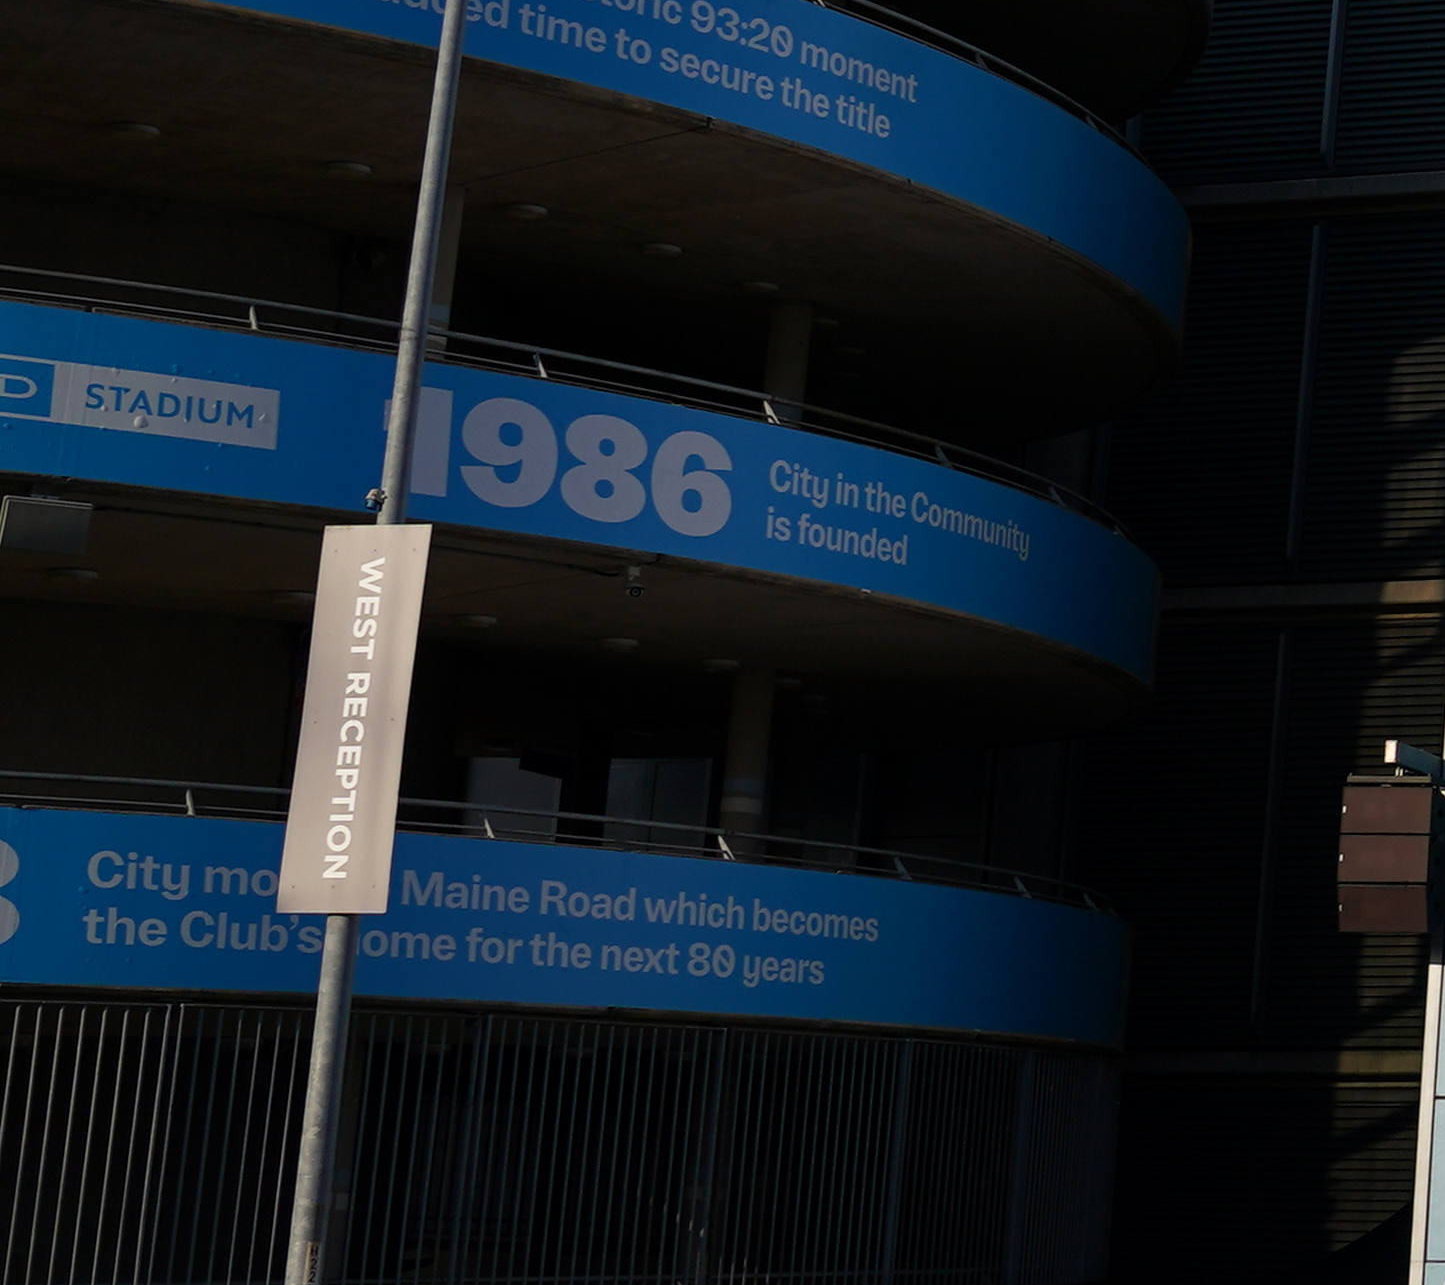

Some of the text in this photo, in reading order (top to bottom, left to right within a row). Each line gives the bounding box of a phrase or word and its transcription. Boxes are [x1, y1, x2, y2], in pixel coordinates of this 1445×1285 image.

[519, 3, 607, 54] time
[614, 26, 652, 65] to
[659, 47, 775, 101] secure
[779, 76, 831, 119] the
[835, 94, 892, 140] title
[691, 0, 794, 58] 93:20
[800, 39, 919, 103] moment
[85, 382, 255, 429] STADIUM
[383, 387, 734, 538] 1986
[768, 459, 1031, 562] City in the Community
[765, 506, 909, 566] is founded
[322, 556, 387, 881] WEST RECEPTION
[82, 906, 825, 990] the Club's for the next 80 years
[87, 849, 880, 944] City Maine Road which becomes
